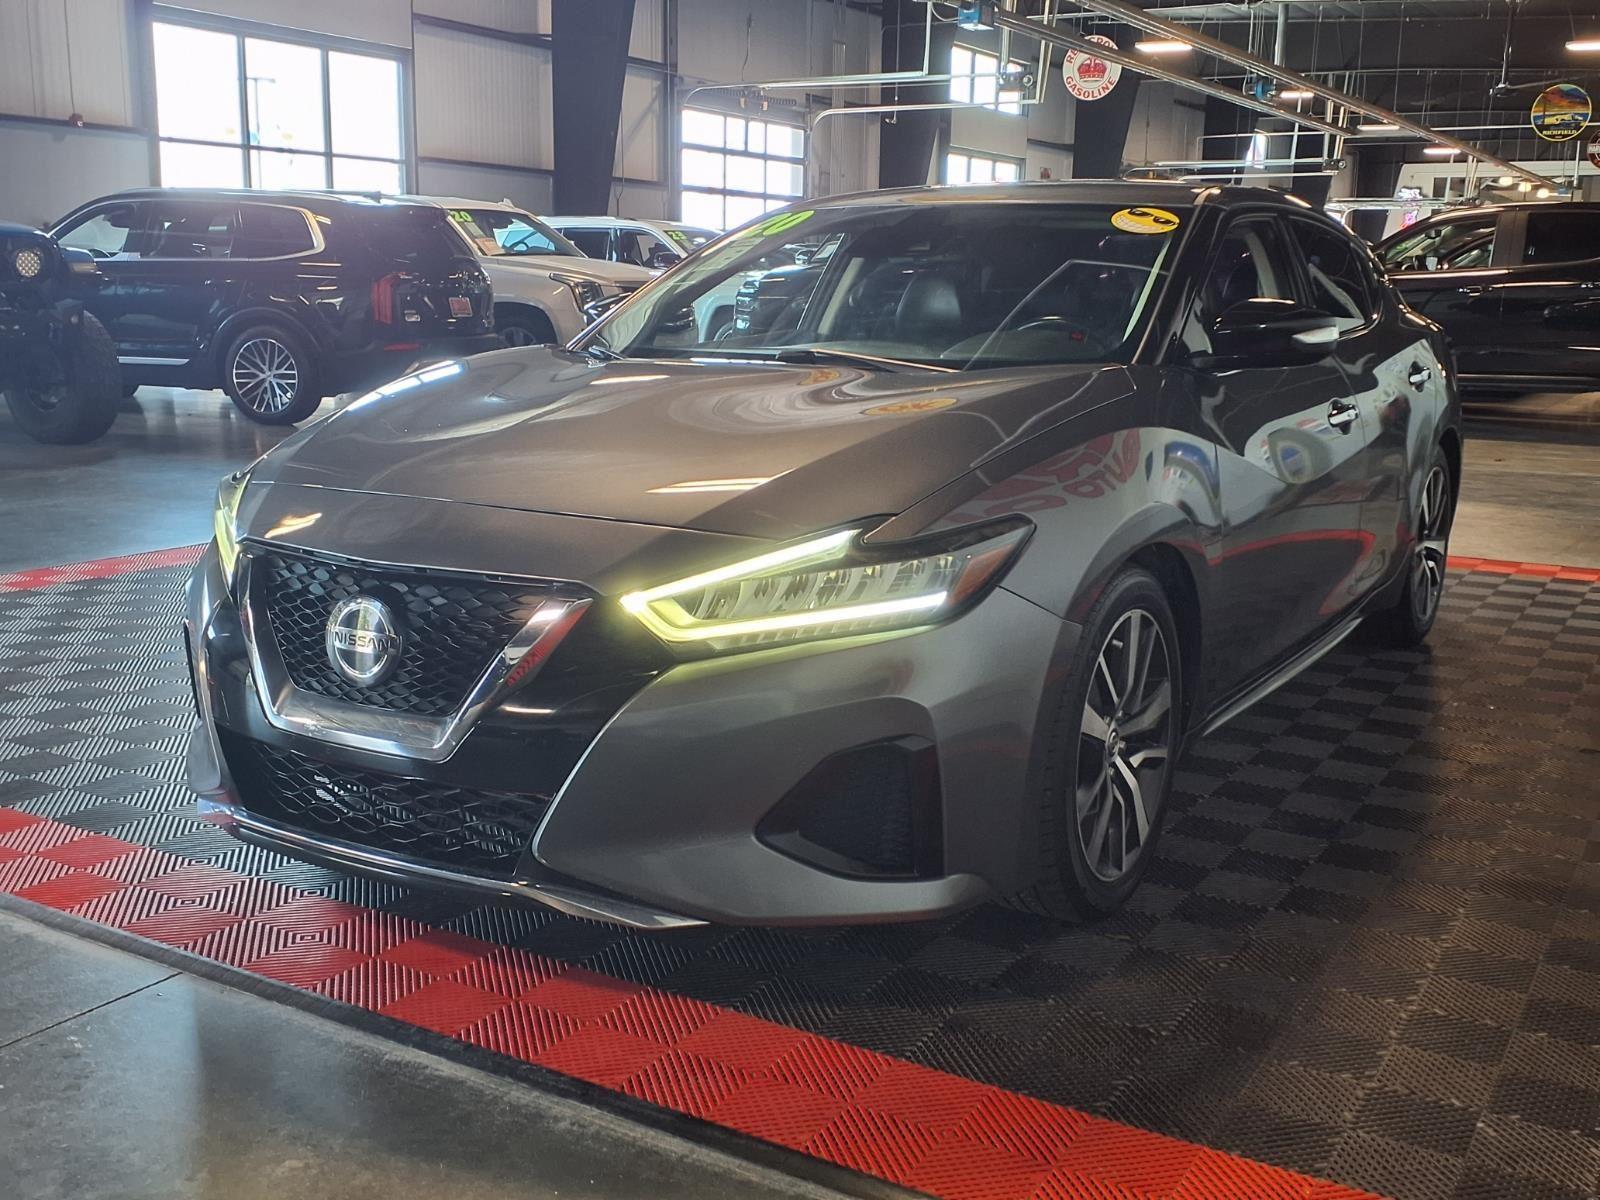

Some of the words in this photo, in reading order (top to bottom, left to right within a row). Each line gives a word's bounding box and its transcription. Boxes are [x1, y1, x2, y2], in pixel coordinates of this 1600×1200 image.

[1065, 76, 1116, 99] GASOLINE
[450, 210, 473, 223] 20
[334, 631, 389, 653] NISSAN
